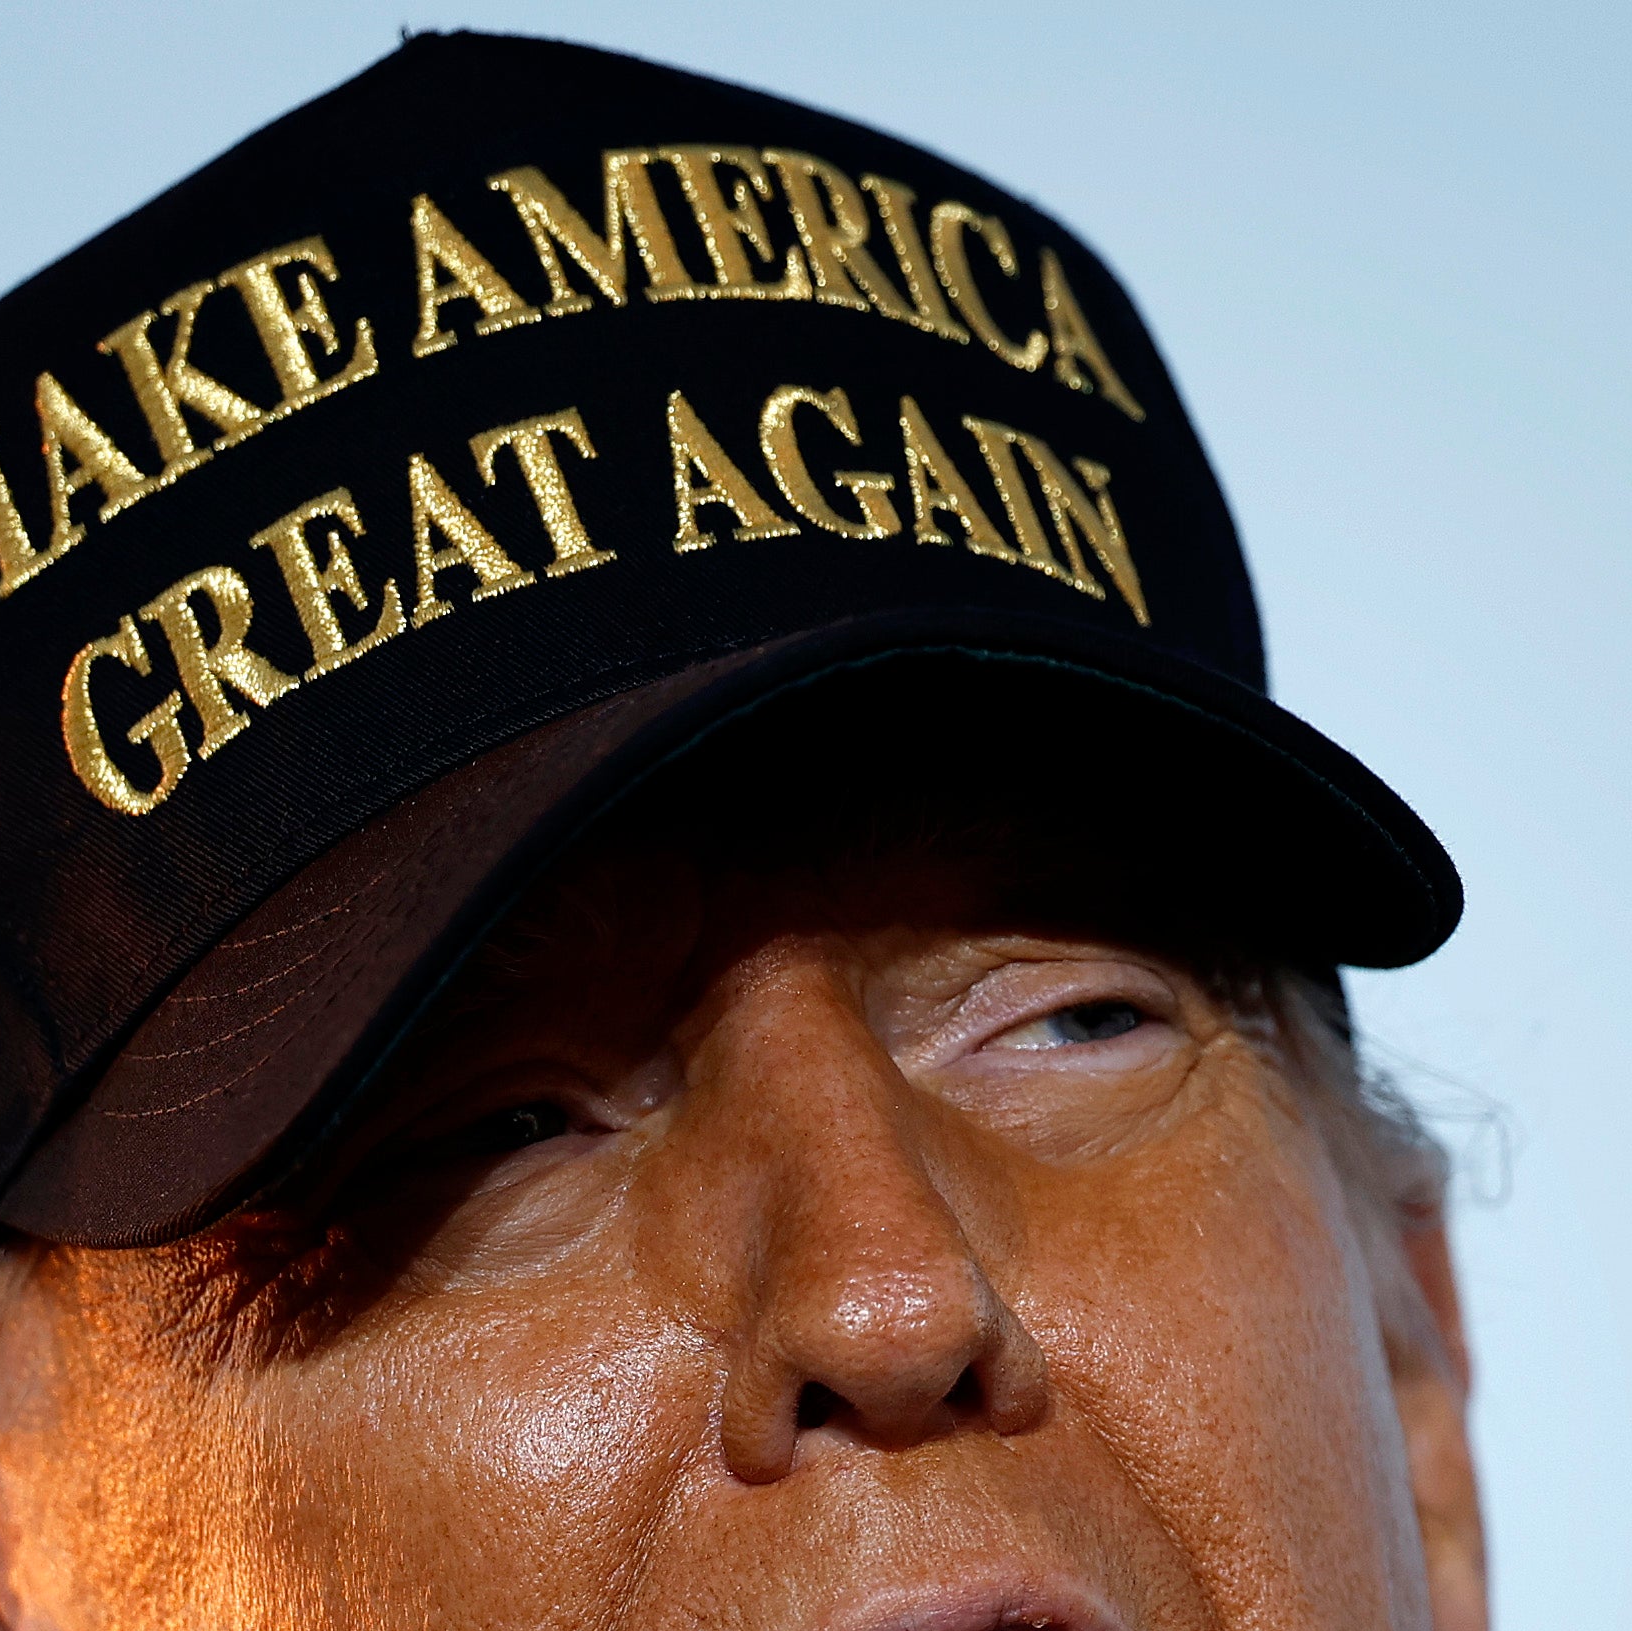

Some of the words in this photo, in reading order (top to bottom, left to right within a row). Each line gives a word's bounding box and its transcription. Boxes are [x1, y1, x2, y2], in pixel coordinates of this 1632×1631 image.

[411, 147, 1142, 416] AMERICA
[61, 408, 617, 816] GREAT
[667, 386, 1148, 624] AGAIN
